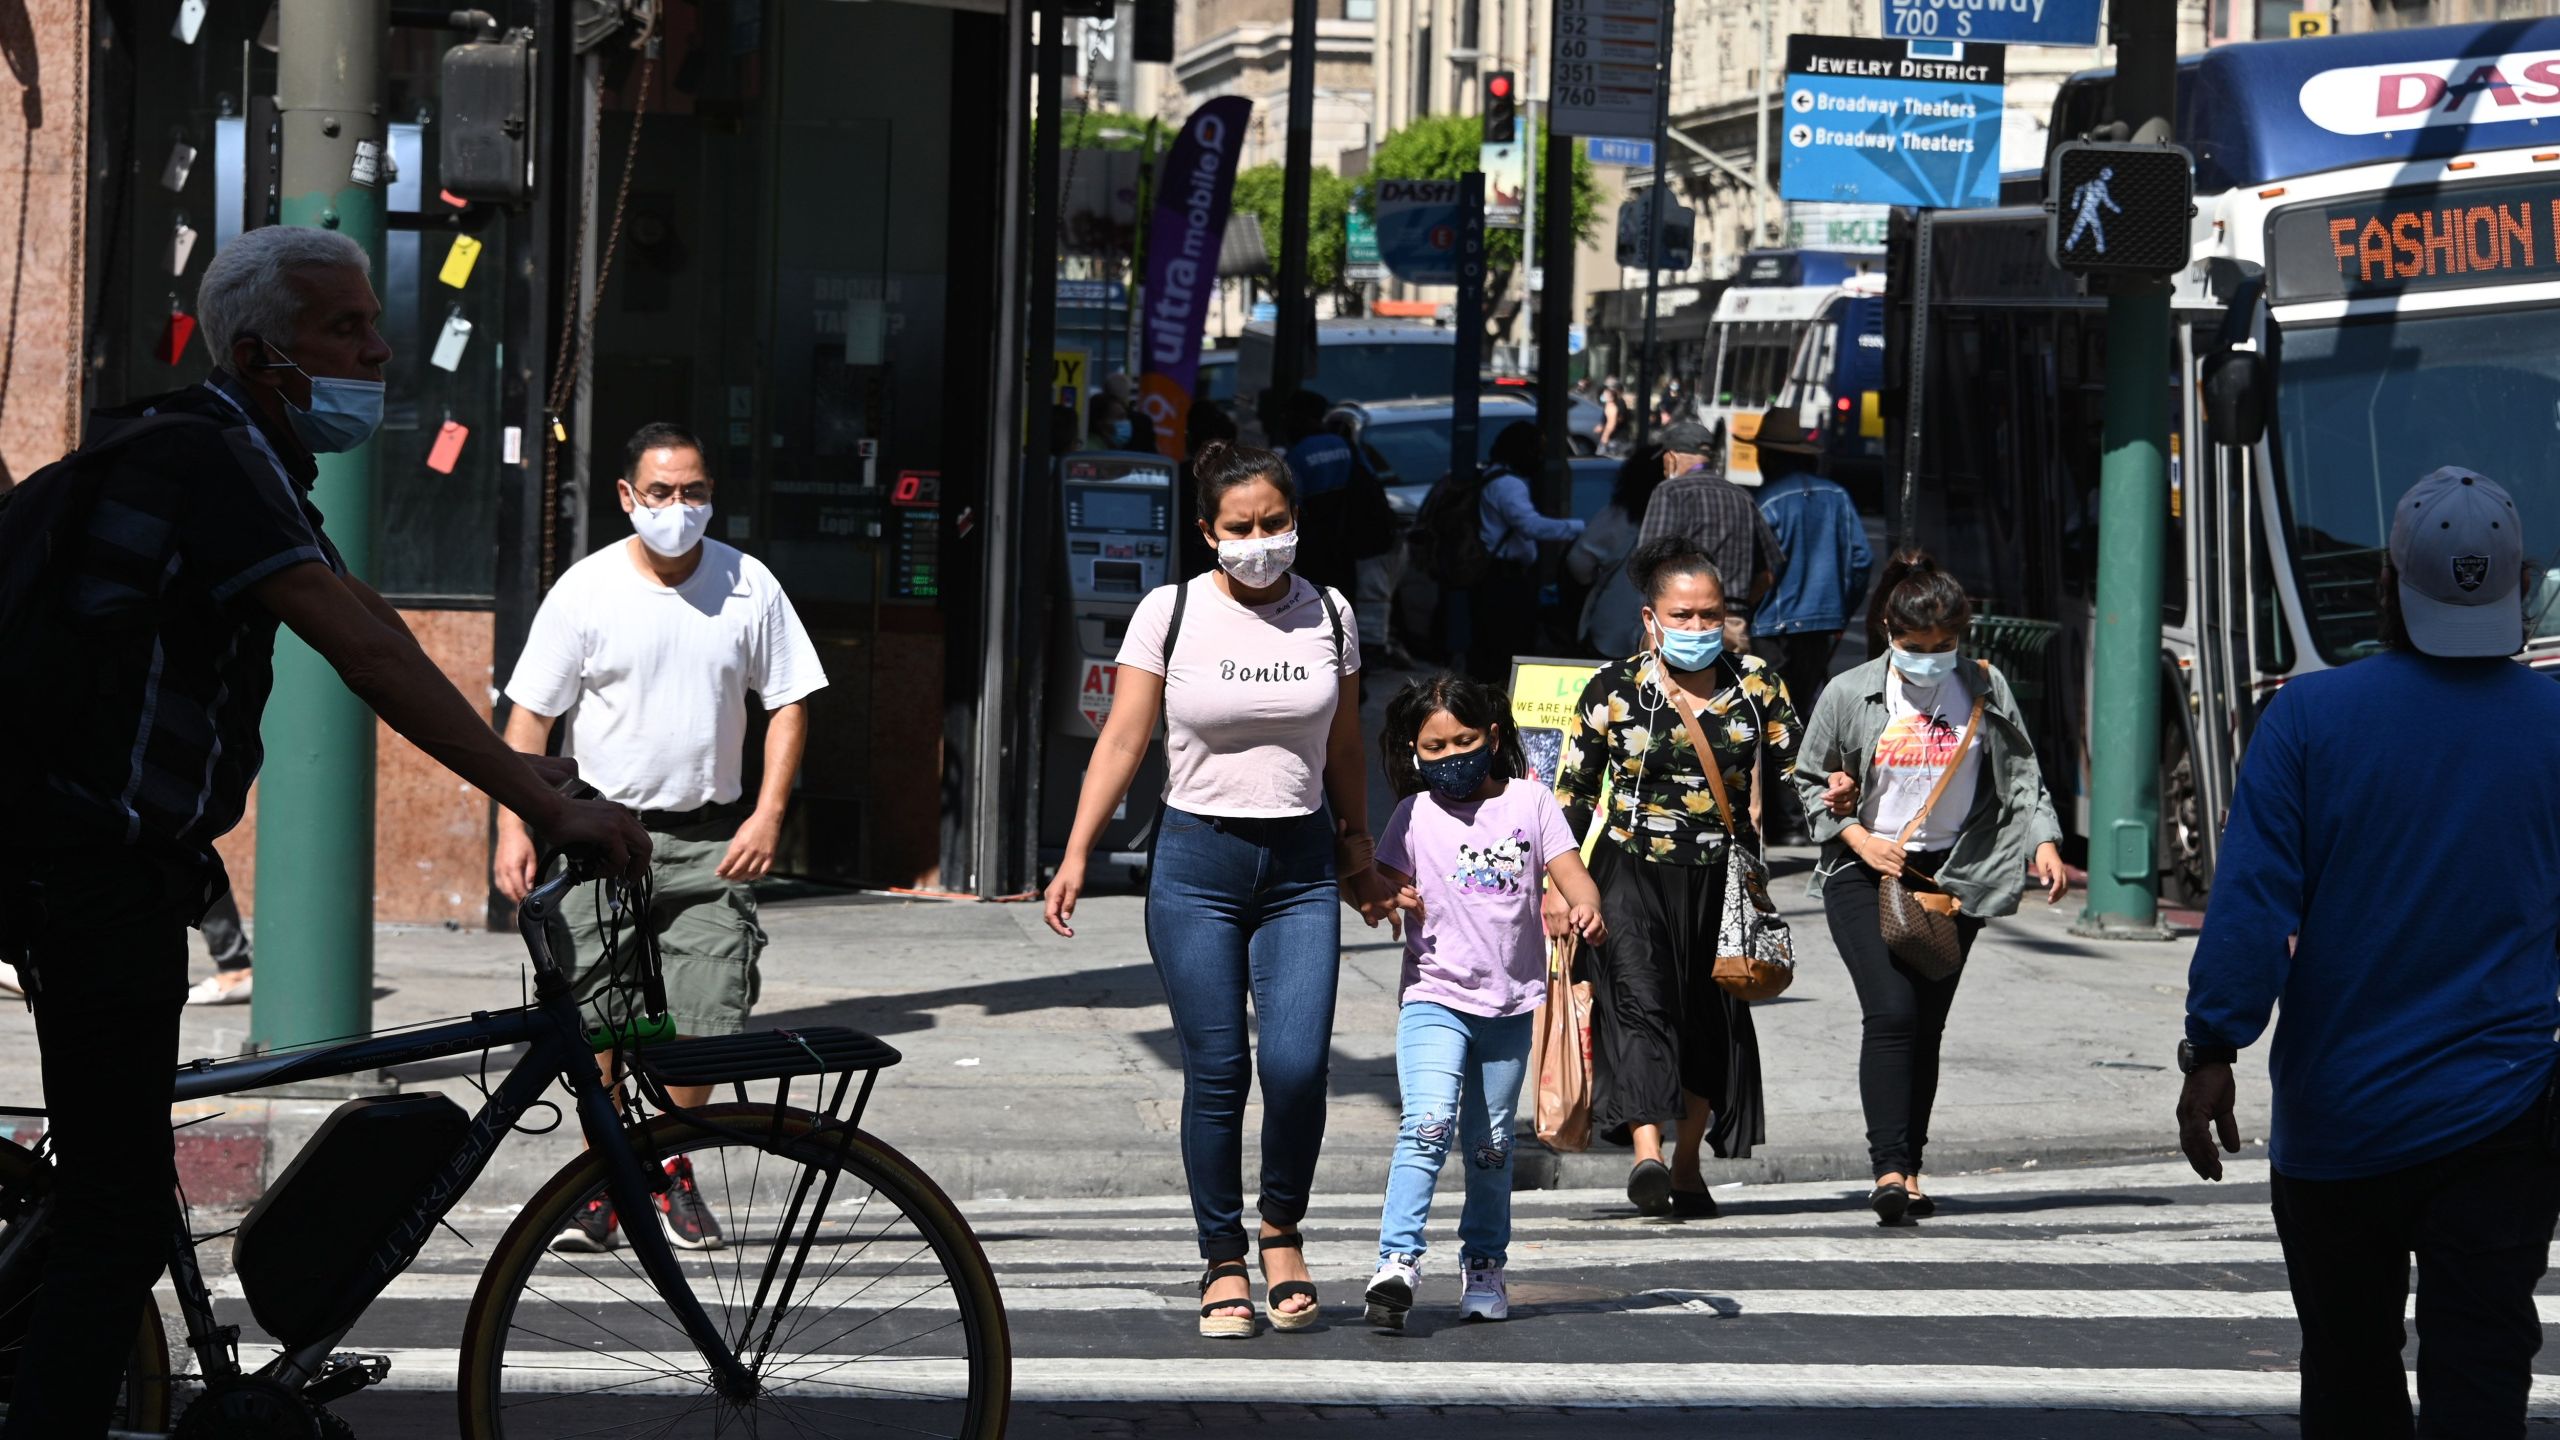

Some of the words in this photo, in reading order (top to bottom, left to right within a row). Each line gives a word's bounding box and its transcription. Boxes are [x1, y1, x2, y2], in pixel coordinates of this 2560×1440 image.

[1892, 0, 2045, 23] oadway
[1893, 8, 1938, 36] 700
[1956, 10, 1971, 37] S
[1562, 16, 1587, 36] 52
[2299, 21, 2320, 38] P
[1561, 40, 1587, 59] 60
[1558, 63, 1594, 83] 351
[1806, 55, 1893, 77] JEWELRY
[1900, 60, 1989, 81] DISTRICT
[1557, 86, 1596, 107] 760
[1817, 92, 1898, 117] Broadway
[1903, 96, 1977, 119] Theaters
[1815, 127, 1896, 152] Broadway
[1901, 131, 1975, 153] Theaters
[1382, 183, 1456, 203] DASH
[2328, 202, 2535, 282] FASHION
[1151, 257, 1198, 366] ultra
[1183, 153, 1220, 259] mobile
[1219, 659, 1310, 683] Bonita
[1516, 701, 1535, 712] WE
[1537, 702, 1561, 713] ARE
